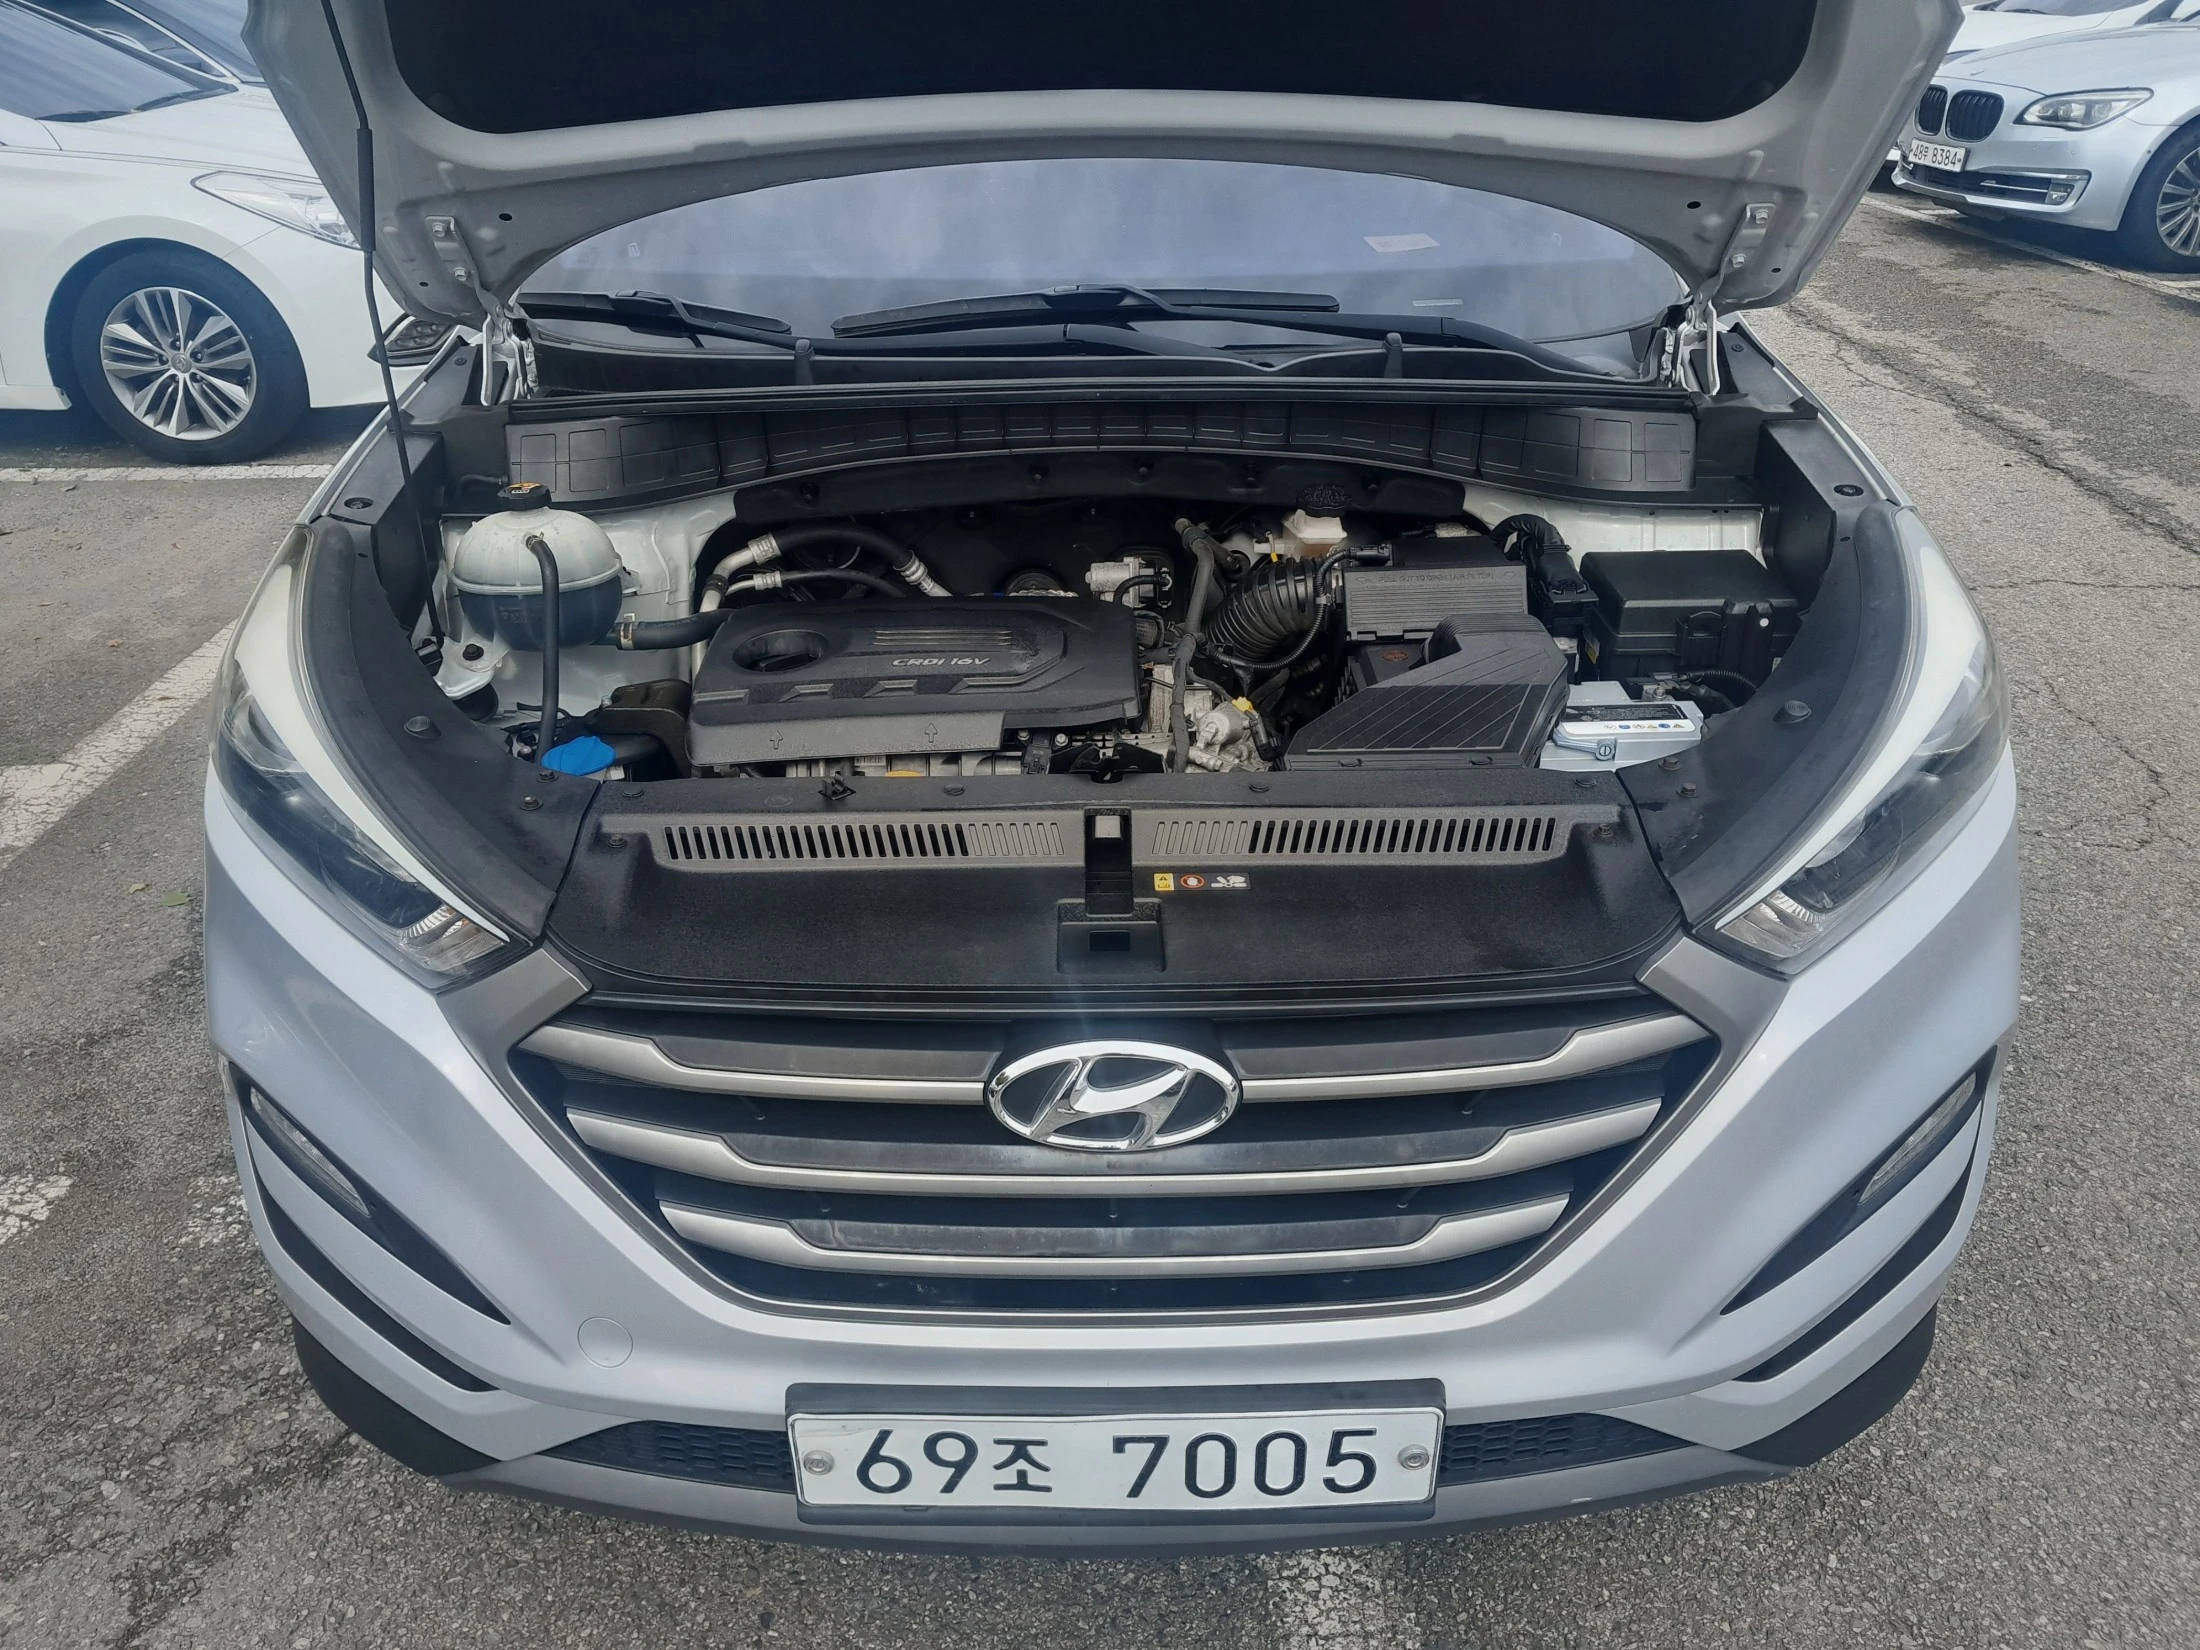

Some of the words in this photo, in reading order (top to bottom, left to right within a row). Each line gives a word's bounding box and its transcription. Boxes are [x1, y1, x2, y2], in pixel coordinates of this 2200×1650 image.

[1931, 147, 1958, 167] 8384
[1415, 574, 1426, 582] TO
[950, 657, 991, 665] 16V
[856, 1428, 1053, 1495] 69조
[1112, 1427, 1378, 1499] 7005
